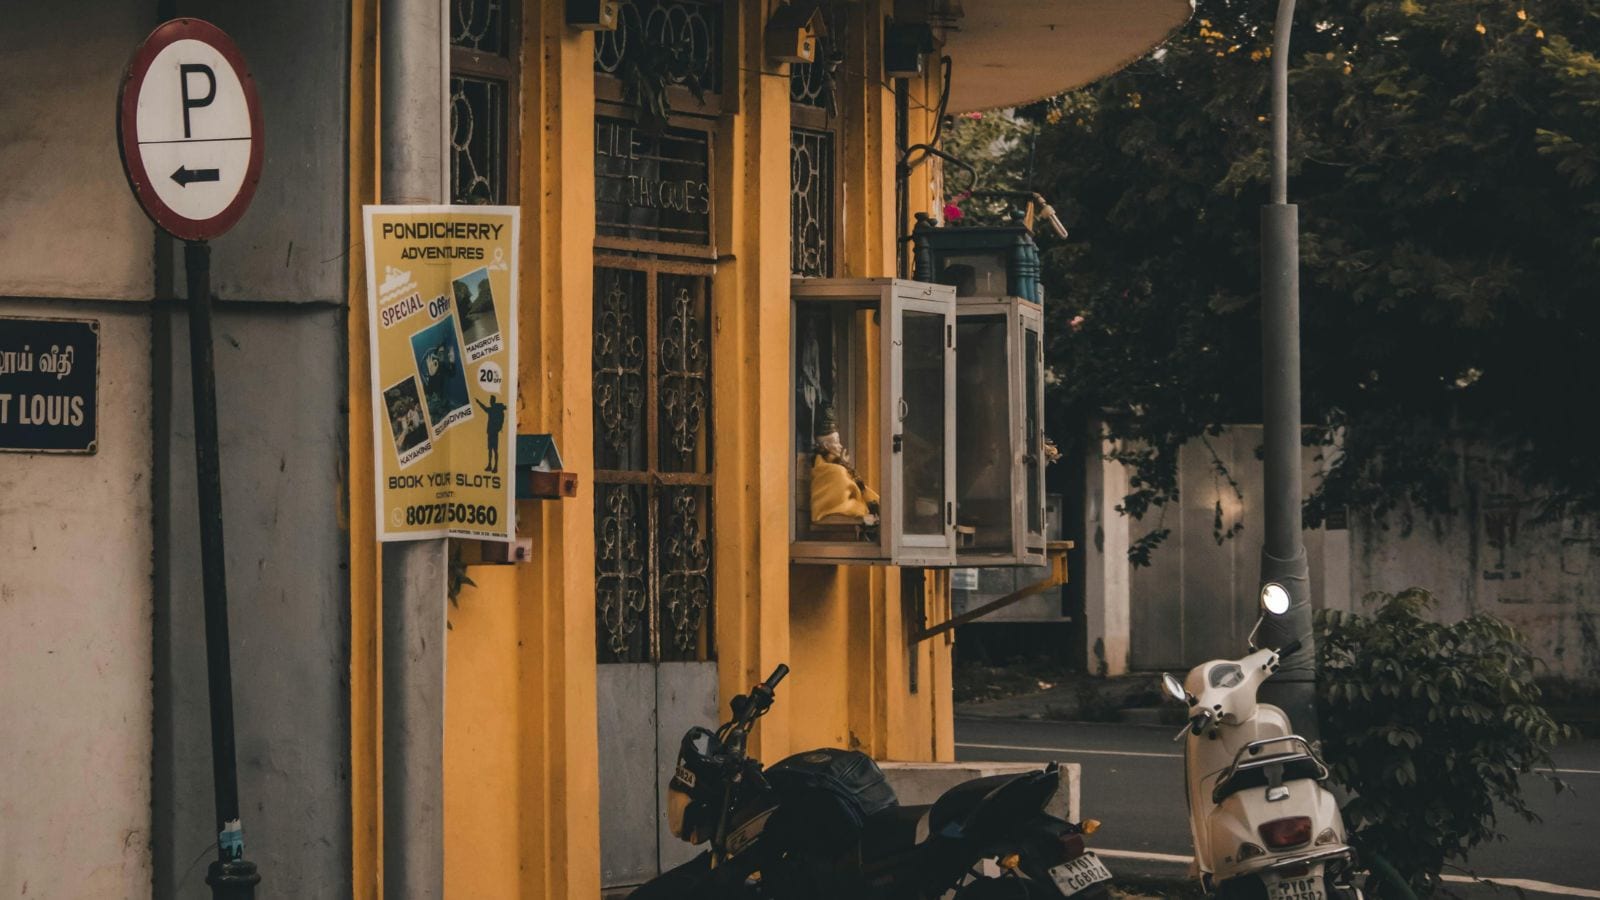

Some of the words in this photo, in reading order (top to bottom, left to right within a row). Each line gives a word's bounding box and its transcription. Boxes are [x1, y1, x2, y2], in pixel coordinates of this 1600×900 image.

[180, 63, 217, 139] P
[382, 222, 504, 240] PONDICHERRY
[400, 246, 484, 260] ADVENTURES
[382, 293, 424, 327] SPECIAL
[466, 334, 501, 353] MANGROVE
[471, 344, 499, 361] BOATING
[39, 344, 74, 380] வீதி
[19, 393, 84, 427] LOUIS
[400, 442, 432, 465] KAYAKING
[388, 474, 424, 489] BOOK
[427, 472, 451, 487] YOUR
[455, 473, 501, 489] SLOTS
[406, 503, 497, 526] 8072750360
